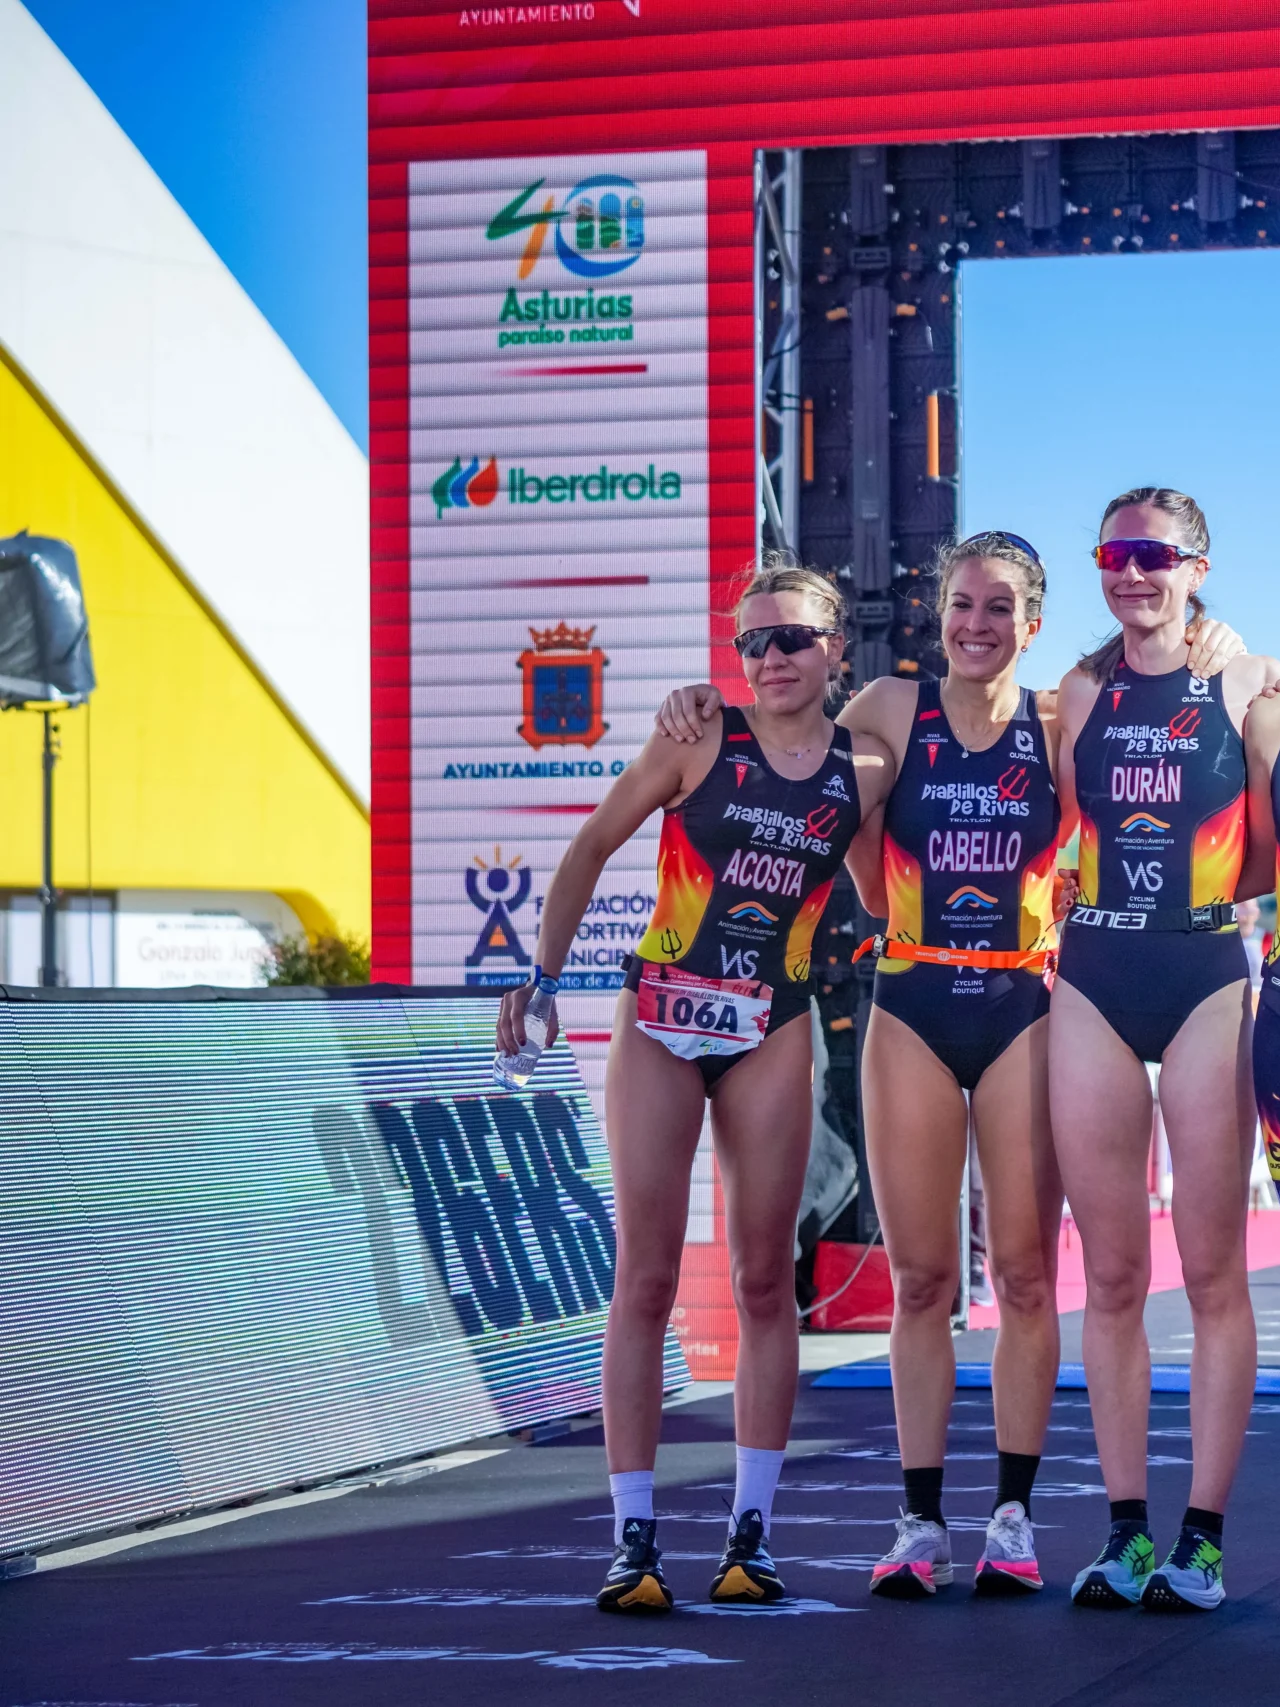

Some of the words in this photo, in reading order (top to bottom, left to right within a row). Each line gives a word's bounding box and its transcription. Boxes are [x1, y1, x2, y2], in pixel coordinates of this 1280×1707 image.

[459, 3, 595, 27] AYUNTAMIENTO
[499, 286, 634, 322] Asturias
[498, 323, 565, 348] paraíso
[569, 324, 634, 343] natural
[508, 463, 682, 504] Iberdrola
[443, 760, 604, 779] AYUNTAMIENTO
[1111, 758, 1182, 803] DURÁN
[928, 829, 1022, 872] CABELLO
[721, 848, 807, 898] ACOSTA
[535, 889, 657, 914] FDACIÓN
[1129, 895, 1155, 903] CYCLING
[952, 987, 985, 995] BOUTIQUE
[655, 993, 738, 1034] 106A
